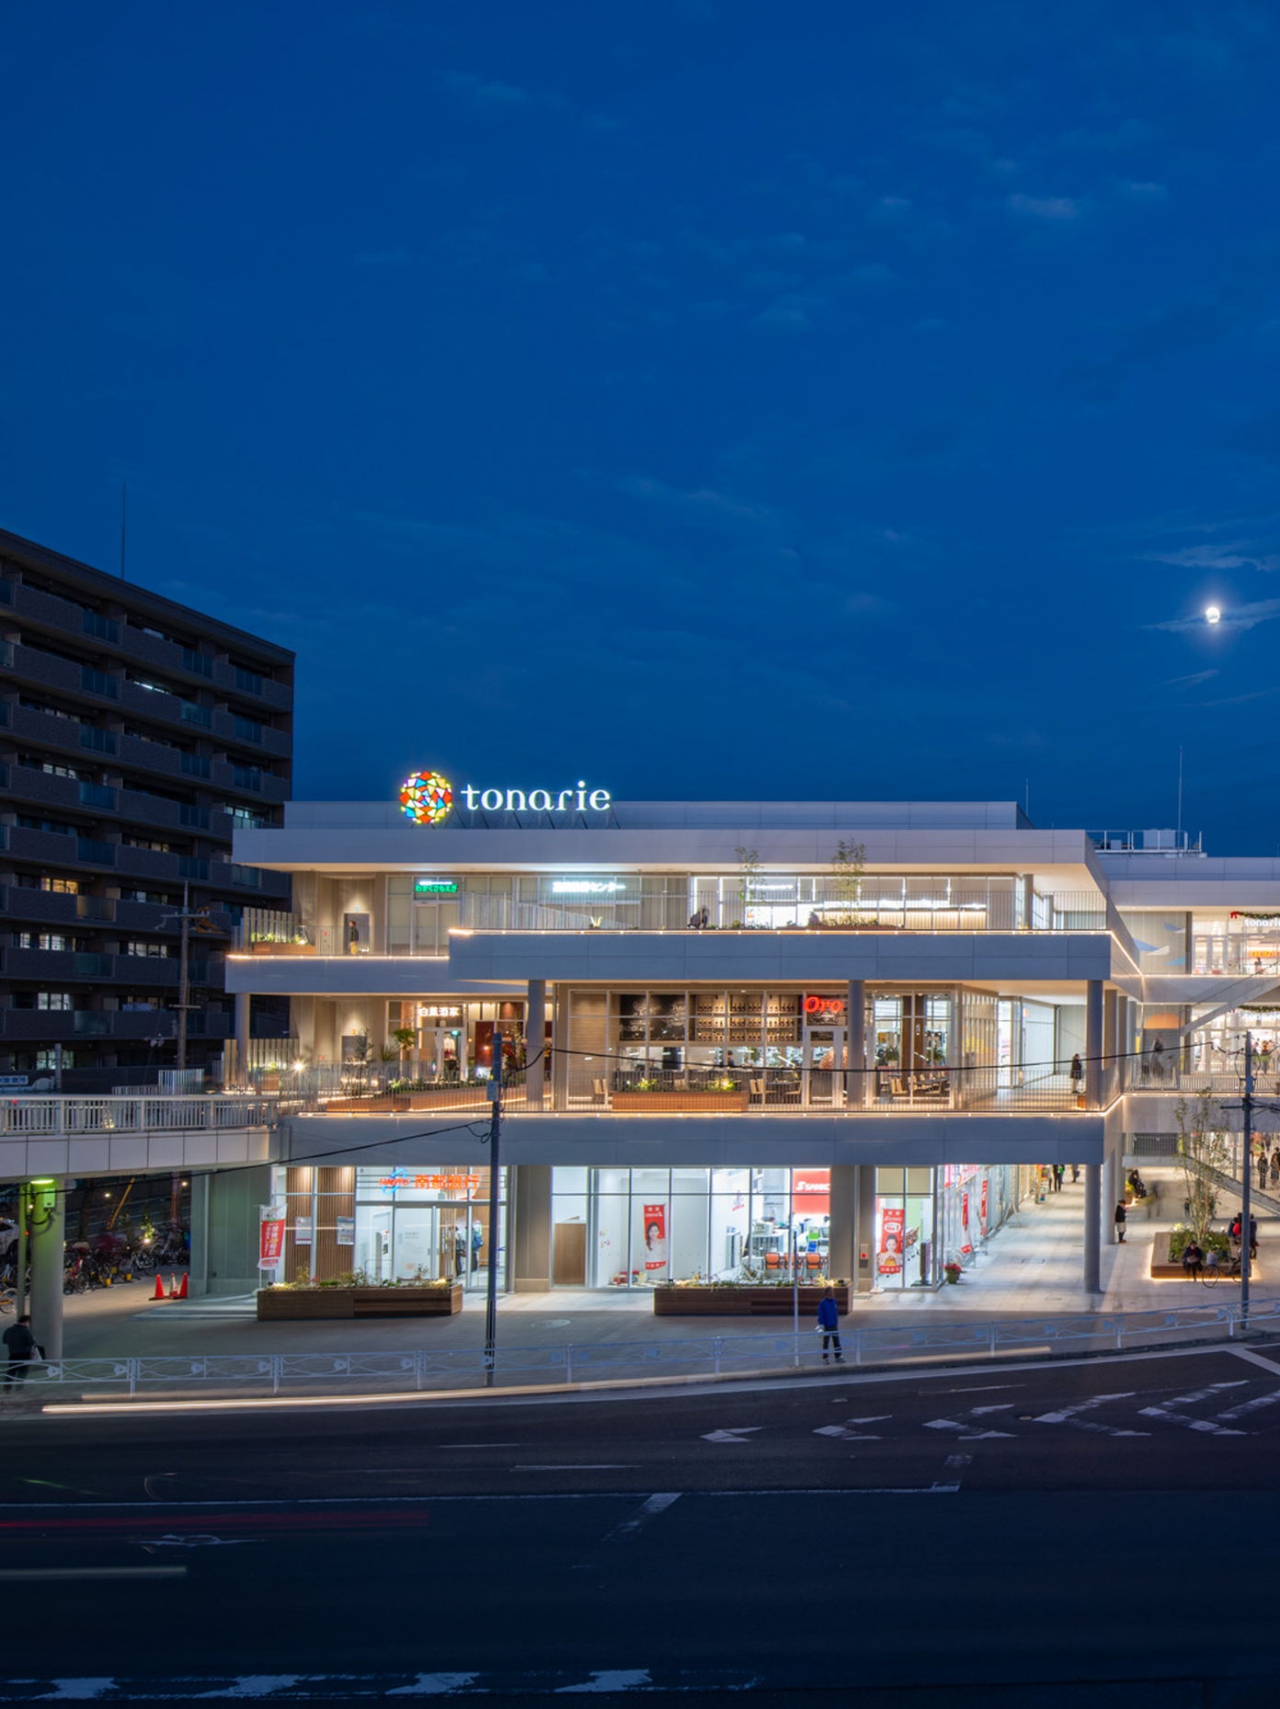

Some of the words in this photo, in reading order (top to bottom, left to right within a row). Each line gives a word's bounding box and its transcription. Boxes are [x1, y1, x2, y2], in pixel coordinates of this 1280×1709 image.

[460, 780, 611, 811] tonarie
[804, 996, 843, 1013] Oro
[414, 1174, 480, 1190] 南都銀行
